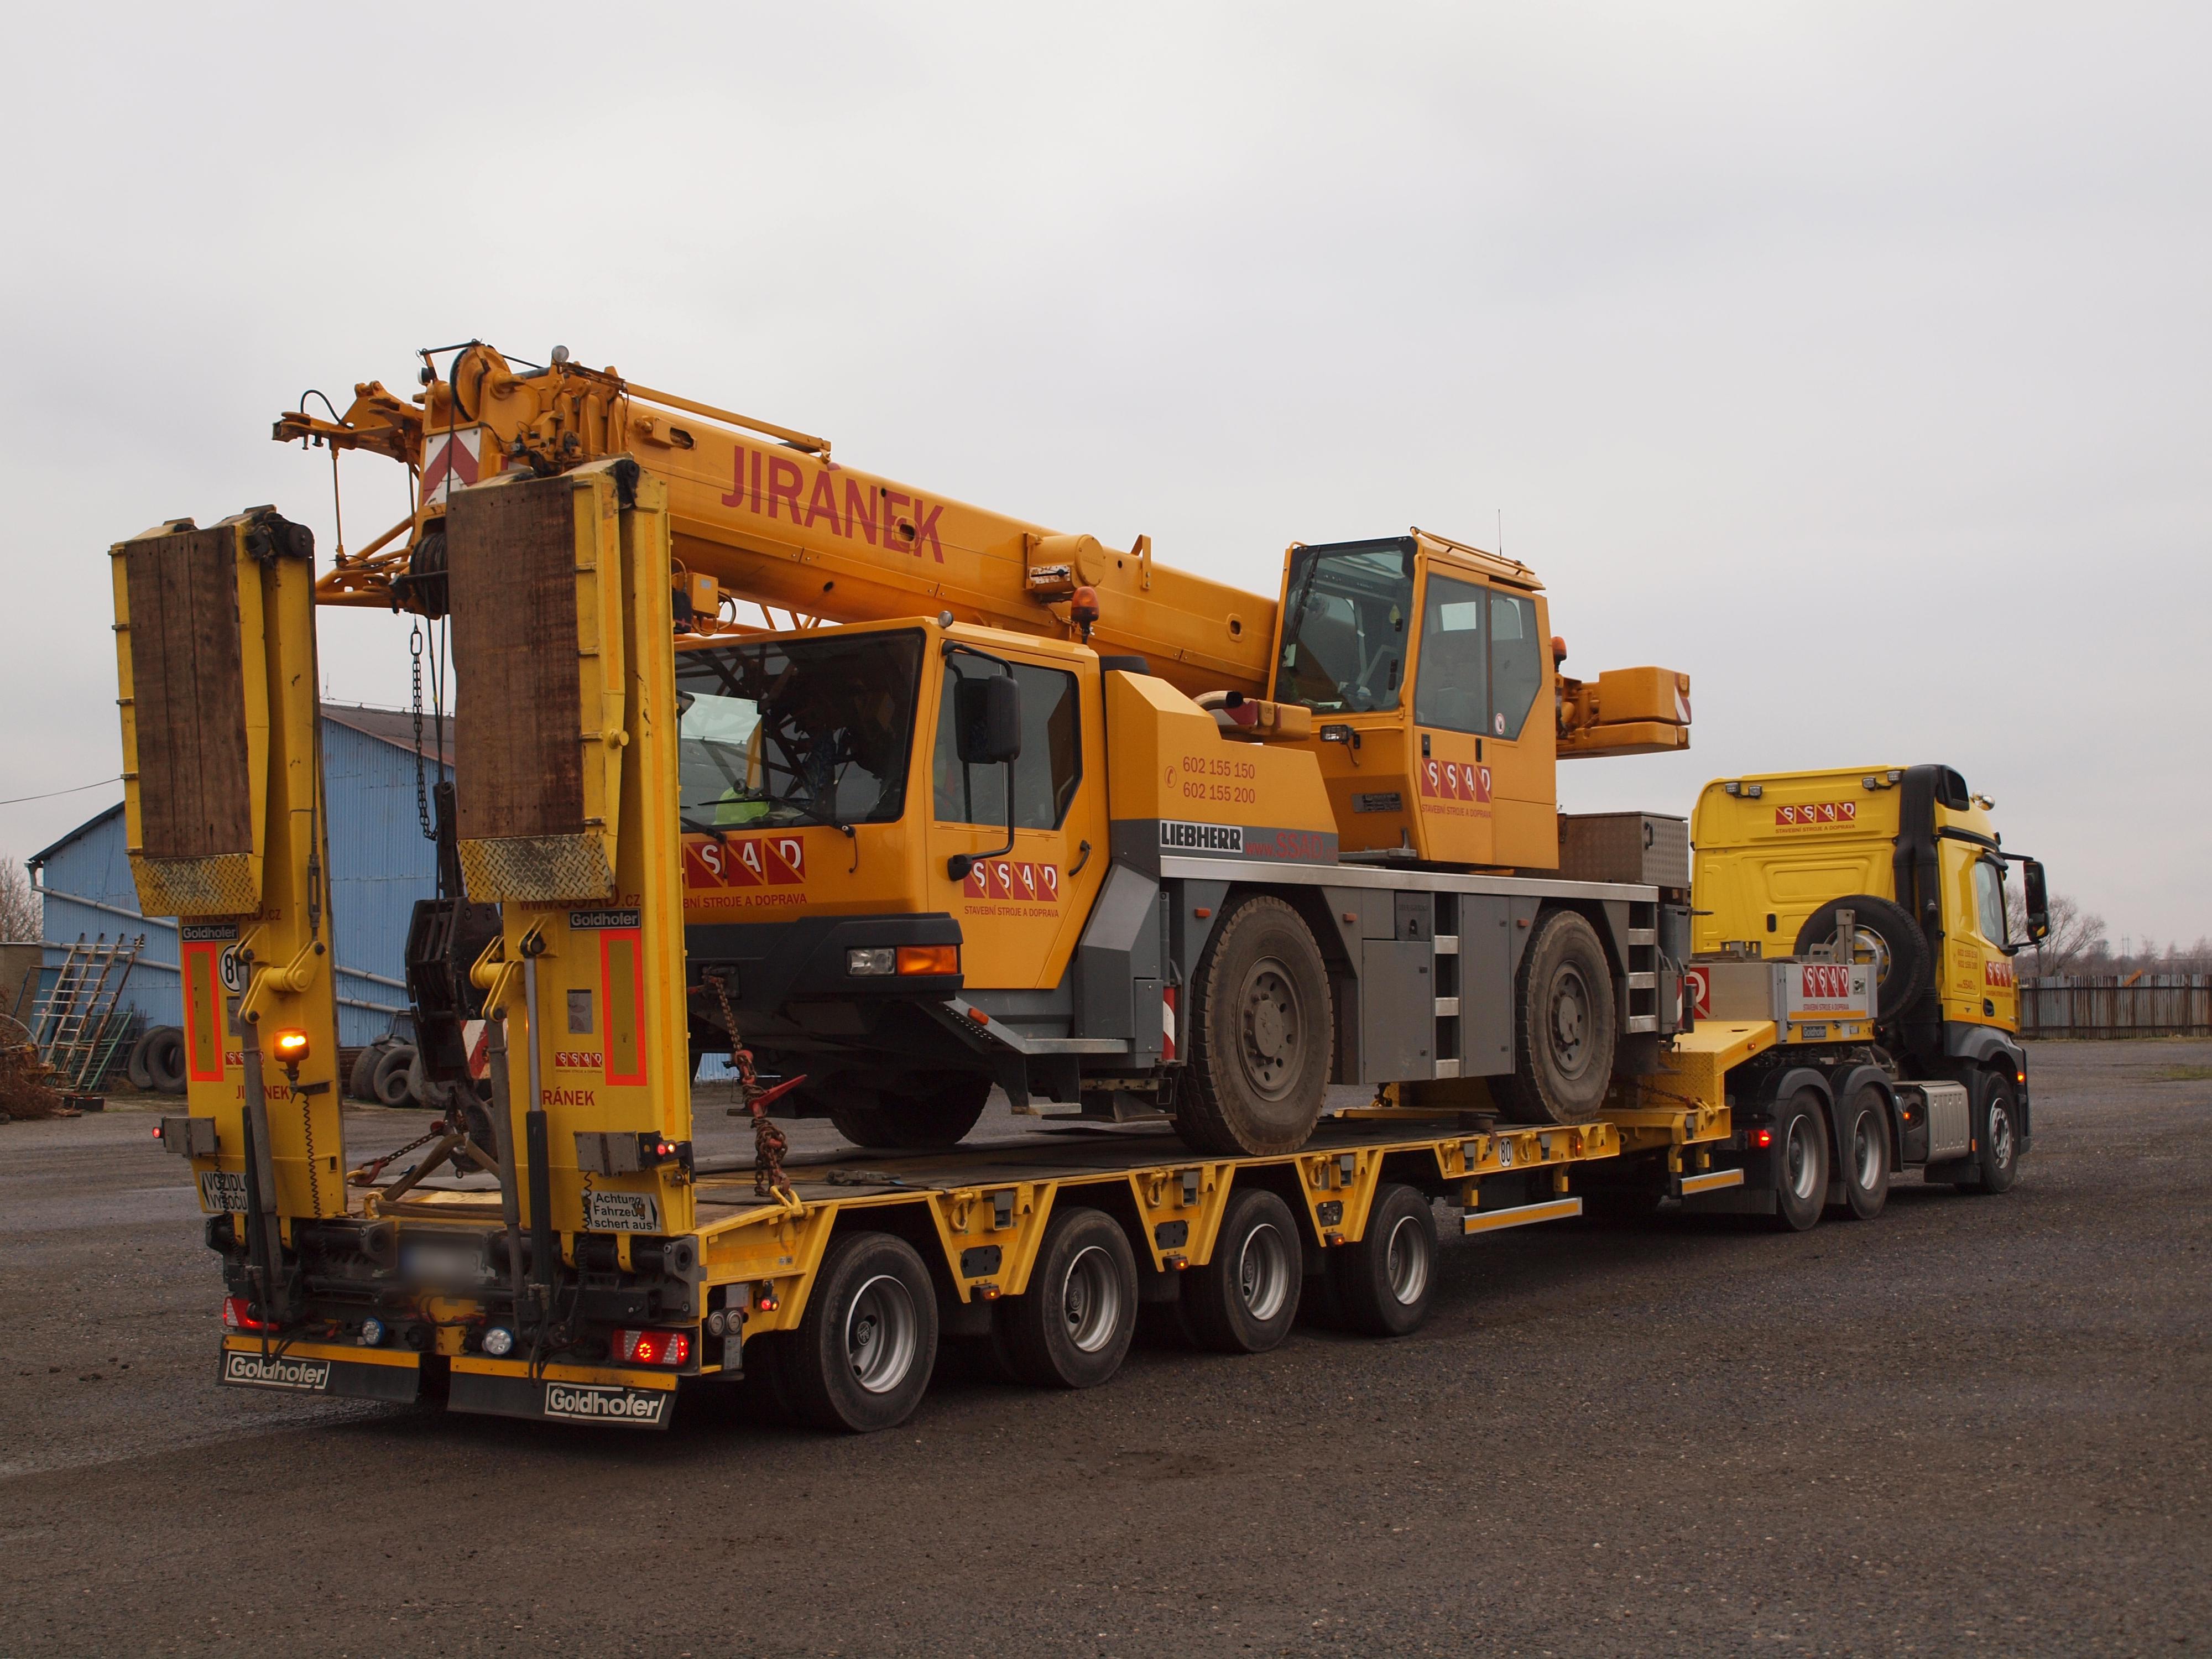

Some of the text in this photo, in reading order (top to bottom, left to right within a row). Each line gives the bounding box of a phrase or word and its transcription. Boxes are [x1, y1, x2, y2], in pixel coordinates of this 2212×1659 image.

[721, 445, 945, 564] JIRÁNEK
[1183, 756, 1255, 779] 602 155 150
[1428, 761, 1490, 792] SSAD
[1183, 781, 1255, 804] 602 155 200
[1446, 806, 1465, 817] STROJE
[1470, 808, 1491, 818] DOPRAVA
[1784, 802, 1855, 820] SSAD
[1161, 822, 1241, 851] LIEBHERR
[973, 862, 1057, 890] SSAD
[703, 896, 742, 909] STROJE
[744, 895, 753, 906] A
[755, 893, 807, 906] DOPRAVA
[964, 904, 1059, 918] STAVEBNÍ STROJE A DOPRAVA
[571, 913, 638, 927] Goldhofer
[183, 926, 236, 939] Goldhofer
[225, 953, 239, 984] 8
[1807, 967, 1848, 989] SSAD
[560, 1052, 602, 1063] SSAD
[236, 1085, 289, 1099] JINEK
[1501, 1141, 1511, 1163] 80
[596, 1193, 643, 1206] Achtung
[594, 1218, 653, 1230] schert aus
[230, 1357, 325, 1383] Goldhofer
[550, 1387, 659, 1416] Goldhofer
